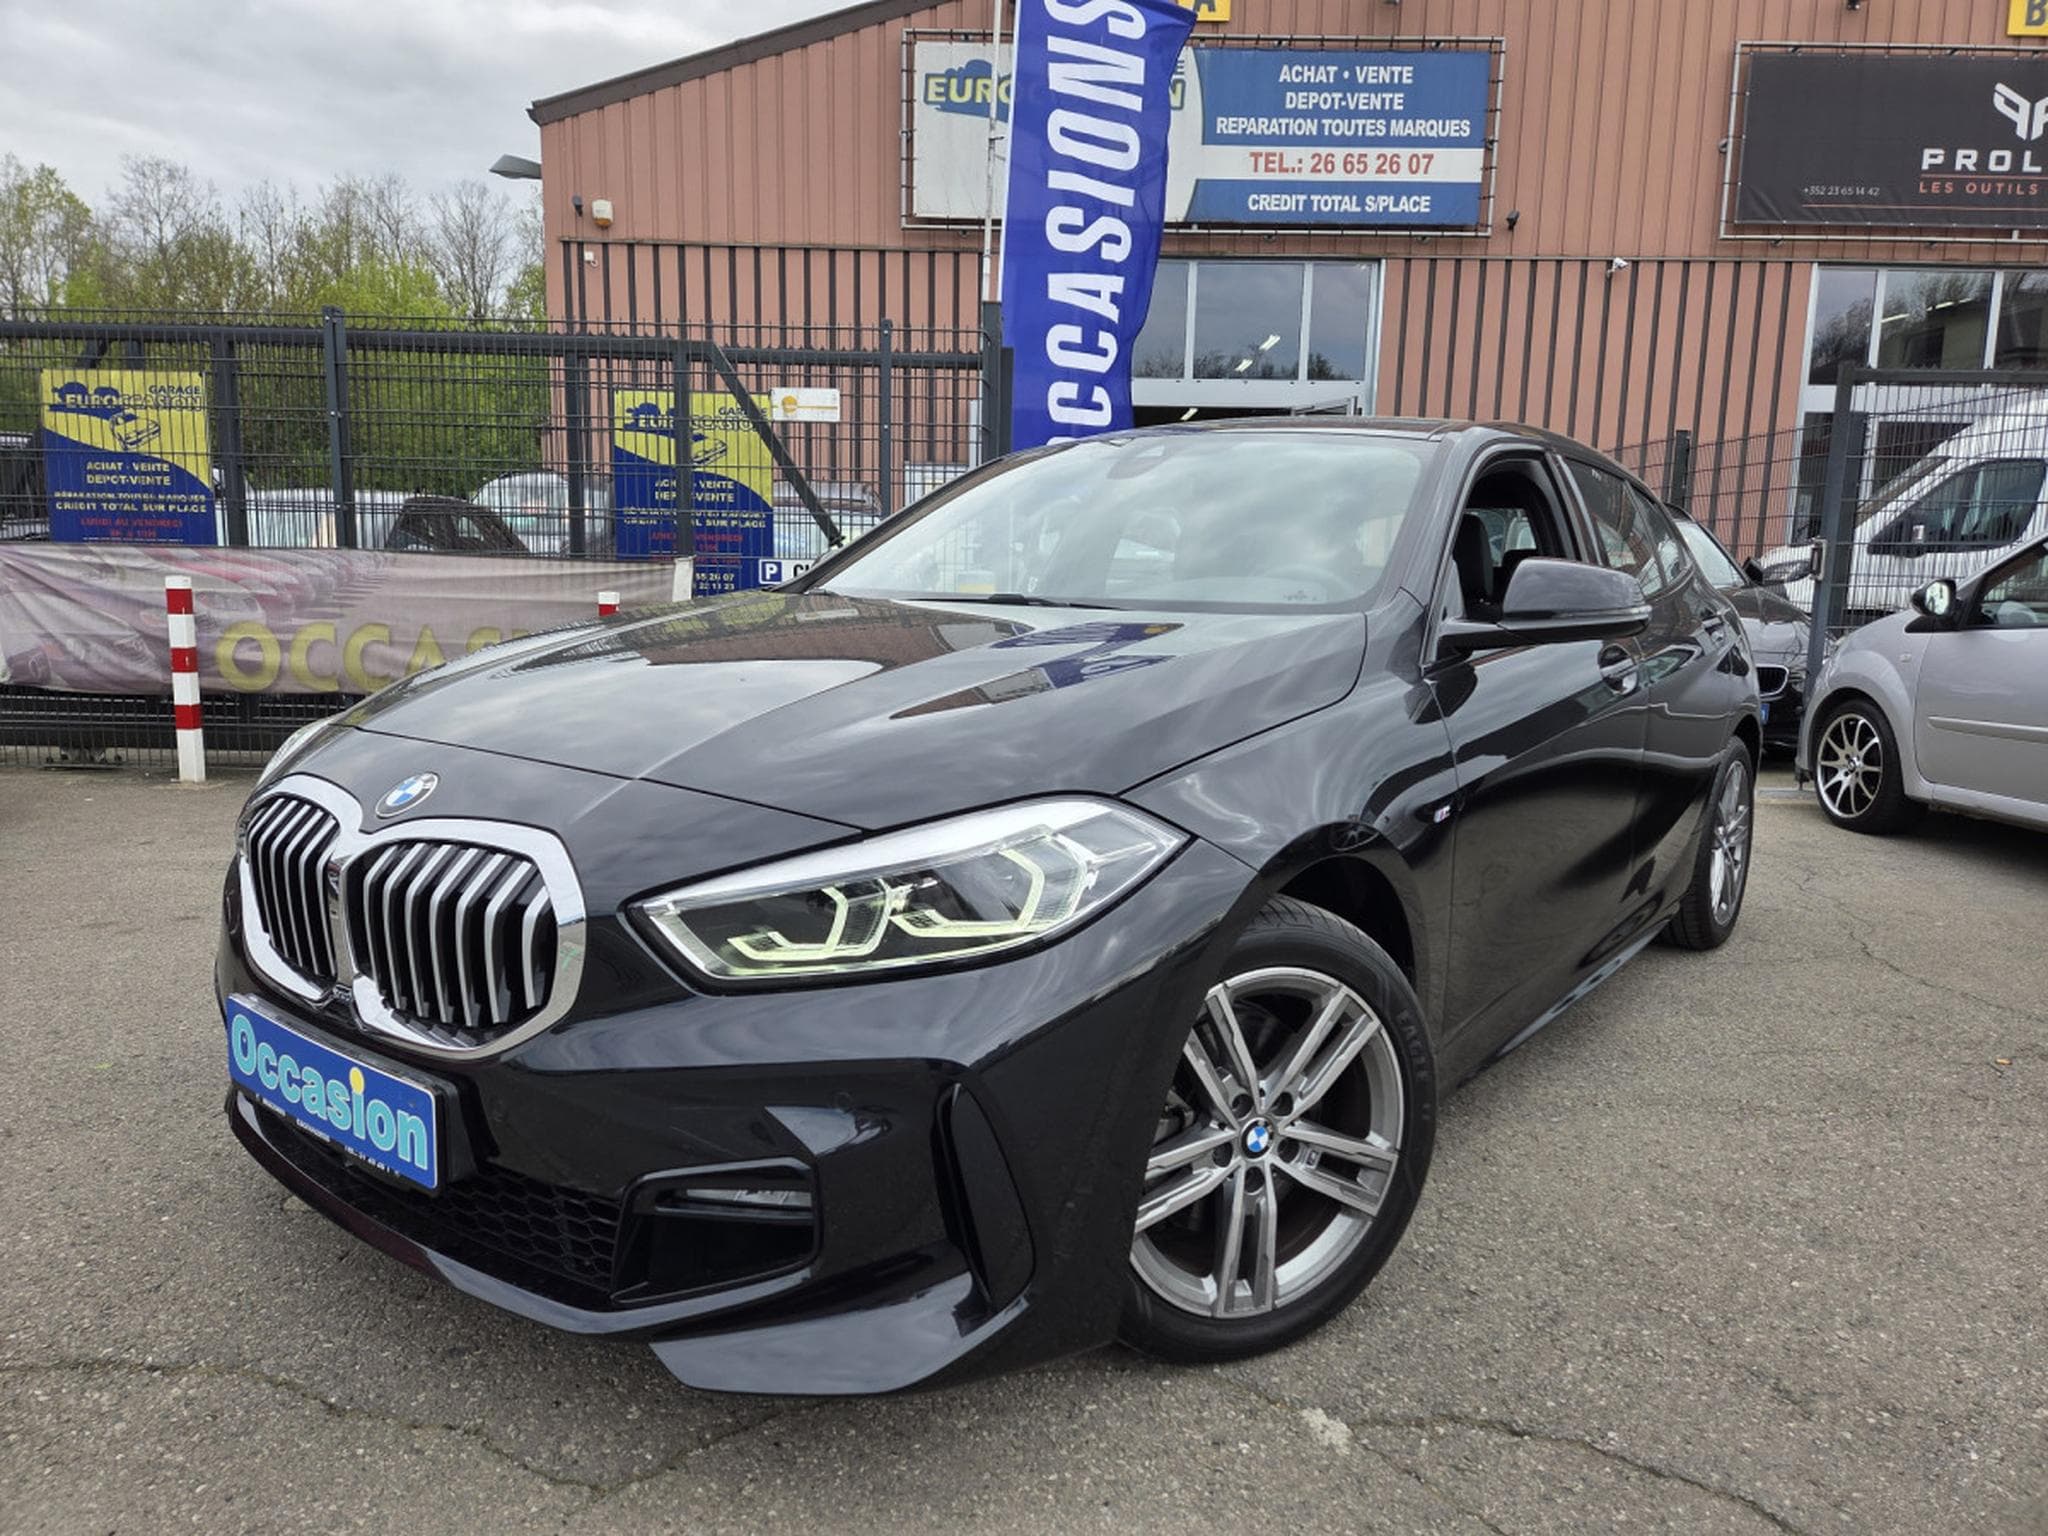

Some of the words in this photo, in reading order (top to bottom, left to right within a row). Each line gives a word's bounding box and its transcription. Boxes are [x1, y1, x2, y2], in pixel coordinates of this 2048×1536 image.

[1278, 64, 1338, 83] ACHAT
[1355, 66, 1414, 84] VENTE
[1285, 92, 1404, 111] DEPOT-VENTE
[1215, 117, 1318, 135] REPARATION
[1321, 119, 1387, 137] TOUTES
[1389, 120, 1471, 138] MARQUES
[1249, 152, 1304, 174] TEL.:
[1310, 153, 1336, 174] 26
[1342, 153, 1369, 174] 65
[1374, 154, 1402, 174] 26
[1407, 154, 1434, 175] 07
[1866, 187, 1880, 196] 42
[1919, 182, 1954, 194] LES
[1965, 182, 2039, 195] OUTILS
[1247, 194, 1308, 212] CREDIT
[1310, 195, 1361, 213] TOTAL
[1364, 195, 1431, 213] S/PLACE
[1045, 0, 1147, 446] CCASIONS
[148, 385, 201, 395] GARAGE
[86, 461, 123, 471] ACHAT
[133, 462, 170, 472] VENTE
[86, 475, 171, 486] DEPOT-VENTE
[699, 481, 735, 490] VENTE
[101, 502, 138, 512] TOTAL
[168, 505, 208, 514] PLACE
[231, 1013, 428, 1171] Occasion
